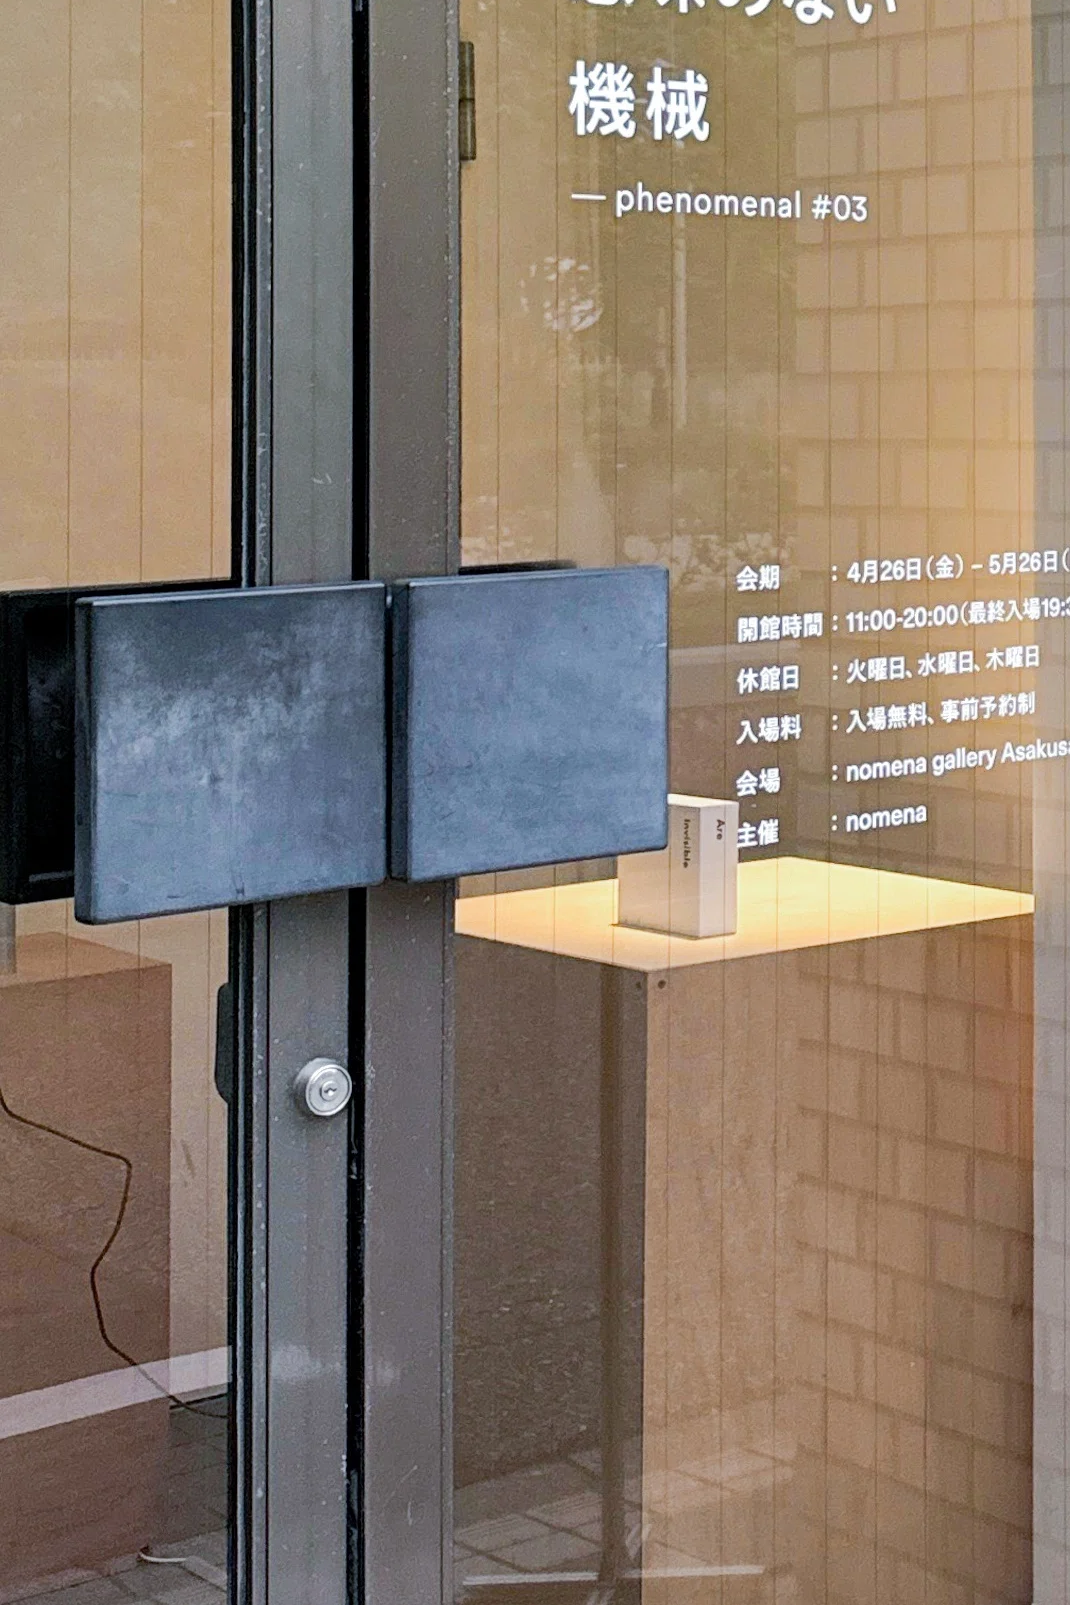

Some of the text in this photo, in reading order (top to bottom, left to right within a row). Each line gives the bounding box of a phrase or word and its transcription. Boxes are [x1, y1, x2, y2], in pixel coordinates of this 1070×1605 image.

[567, 59, 711, 142] 機械
[615, 182, 802, 219] phenomenal
[811, 195, 869, 222] #03
[735, 564, 781, 592] 会期
[737, 611, 824, 643] 開館時間
[736, 665, 800, 695] 休館日
[736, 713, 802, 745] 入場料
[735, 767, 781, 797] 会場
[845, 755, 928, 783] nomena
[931, 747, 998, 777] gallery
[736, 818, 780, 848] 主催
[845, 804, 928, 833] nomena
